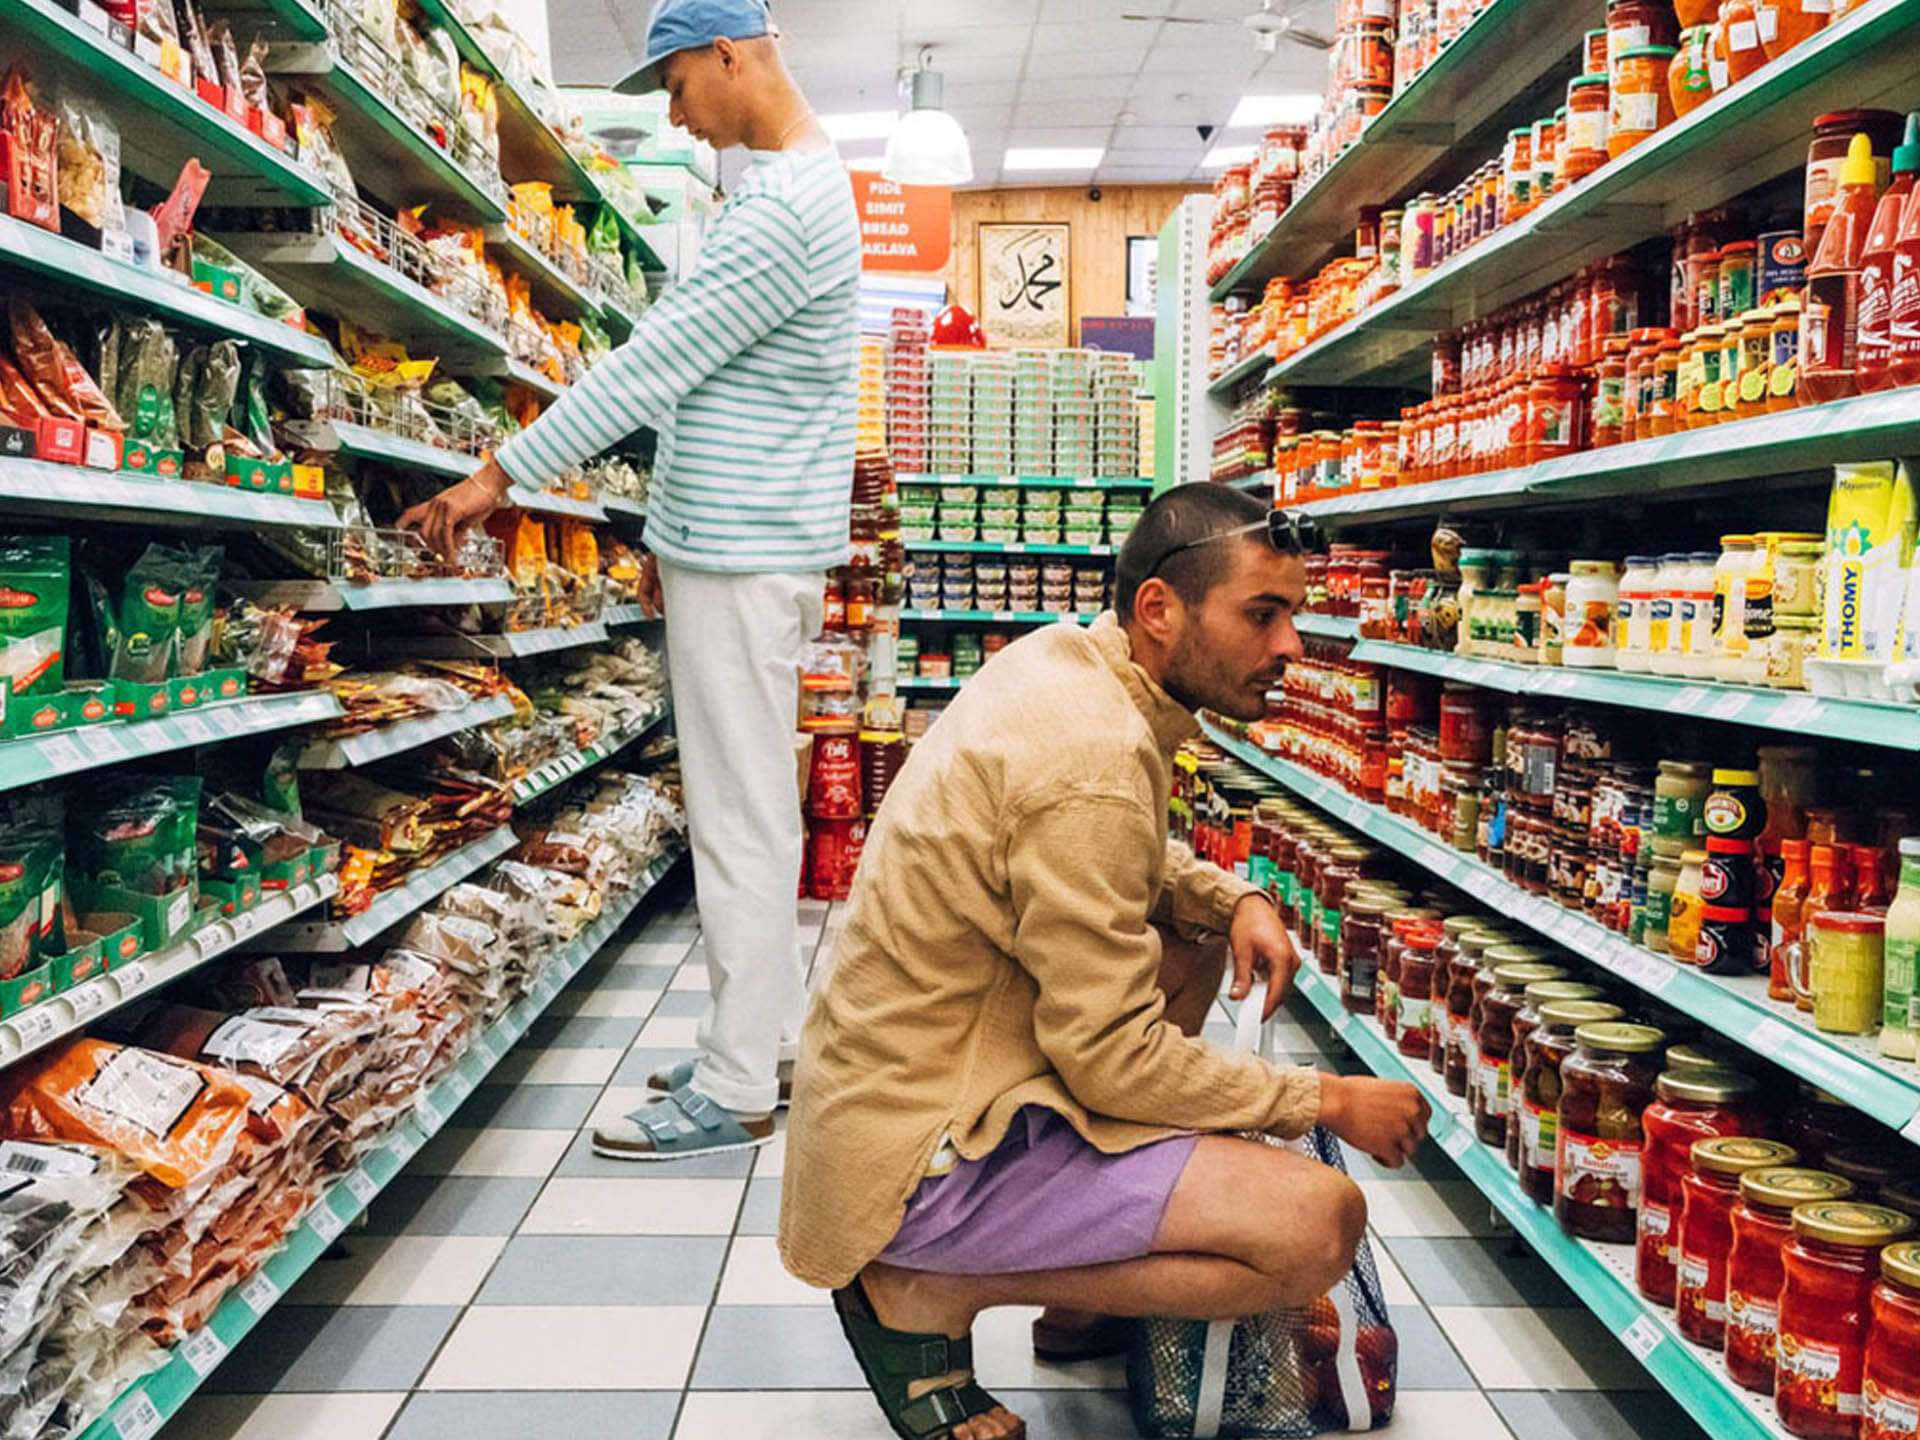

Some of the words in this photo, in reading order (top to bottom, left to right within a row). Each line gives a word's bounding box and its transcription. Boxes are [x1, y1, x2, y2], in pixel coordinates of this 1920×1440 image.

[869, 182, 902, 195] PIDE
[865, 202, 905, 215] SIMIT
[862, 222, 909, 235] BREAD
[862, 243, 918, 257] AKLAVA
[1841, 567, 1858, 649] THOMY
